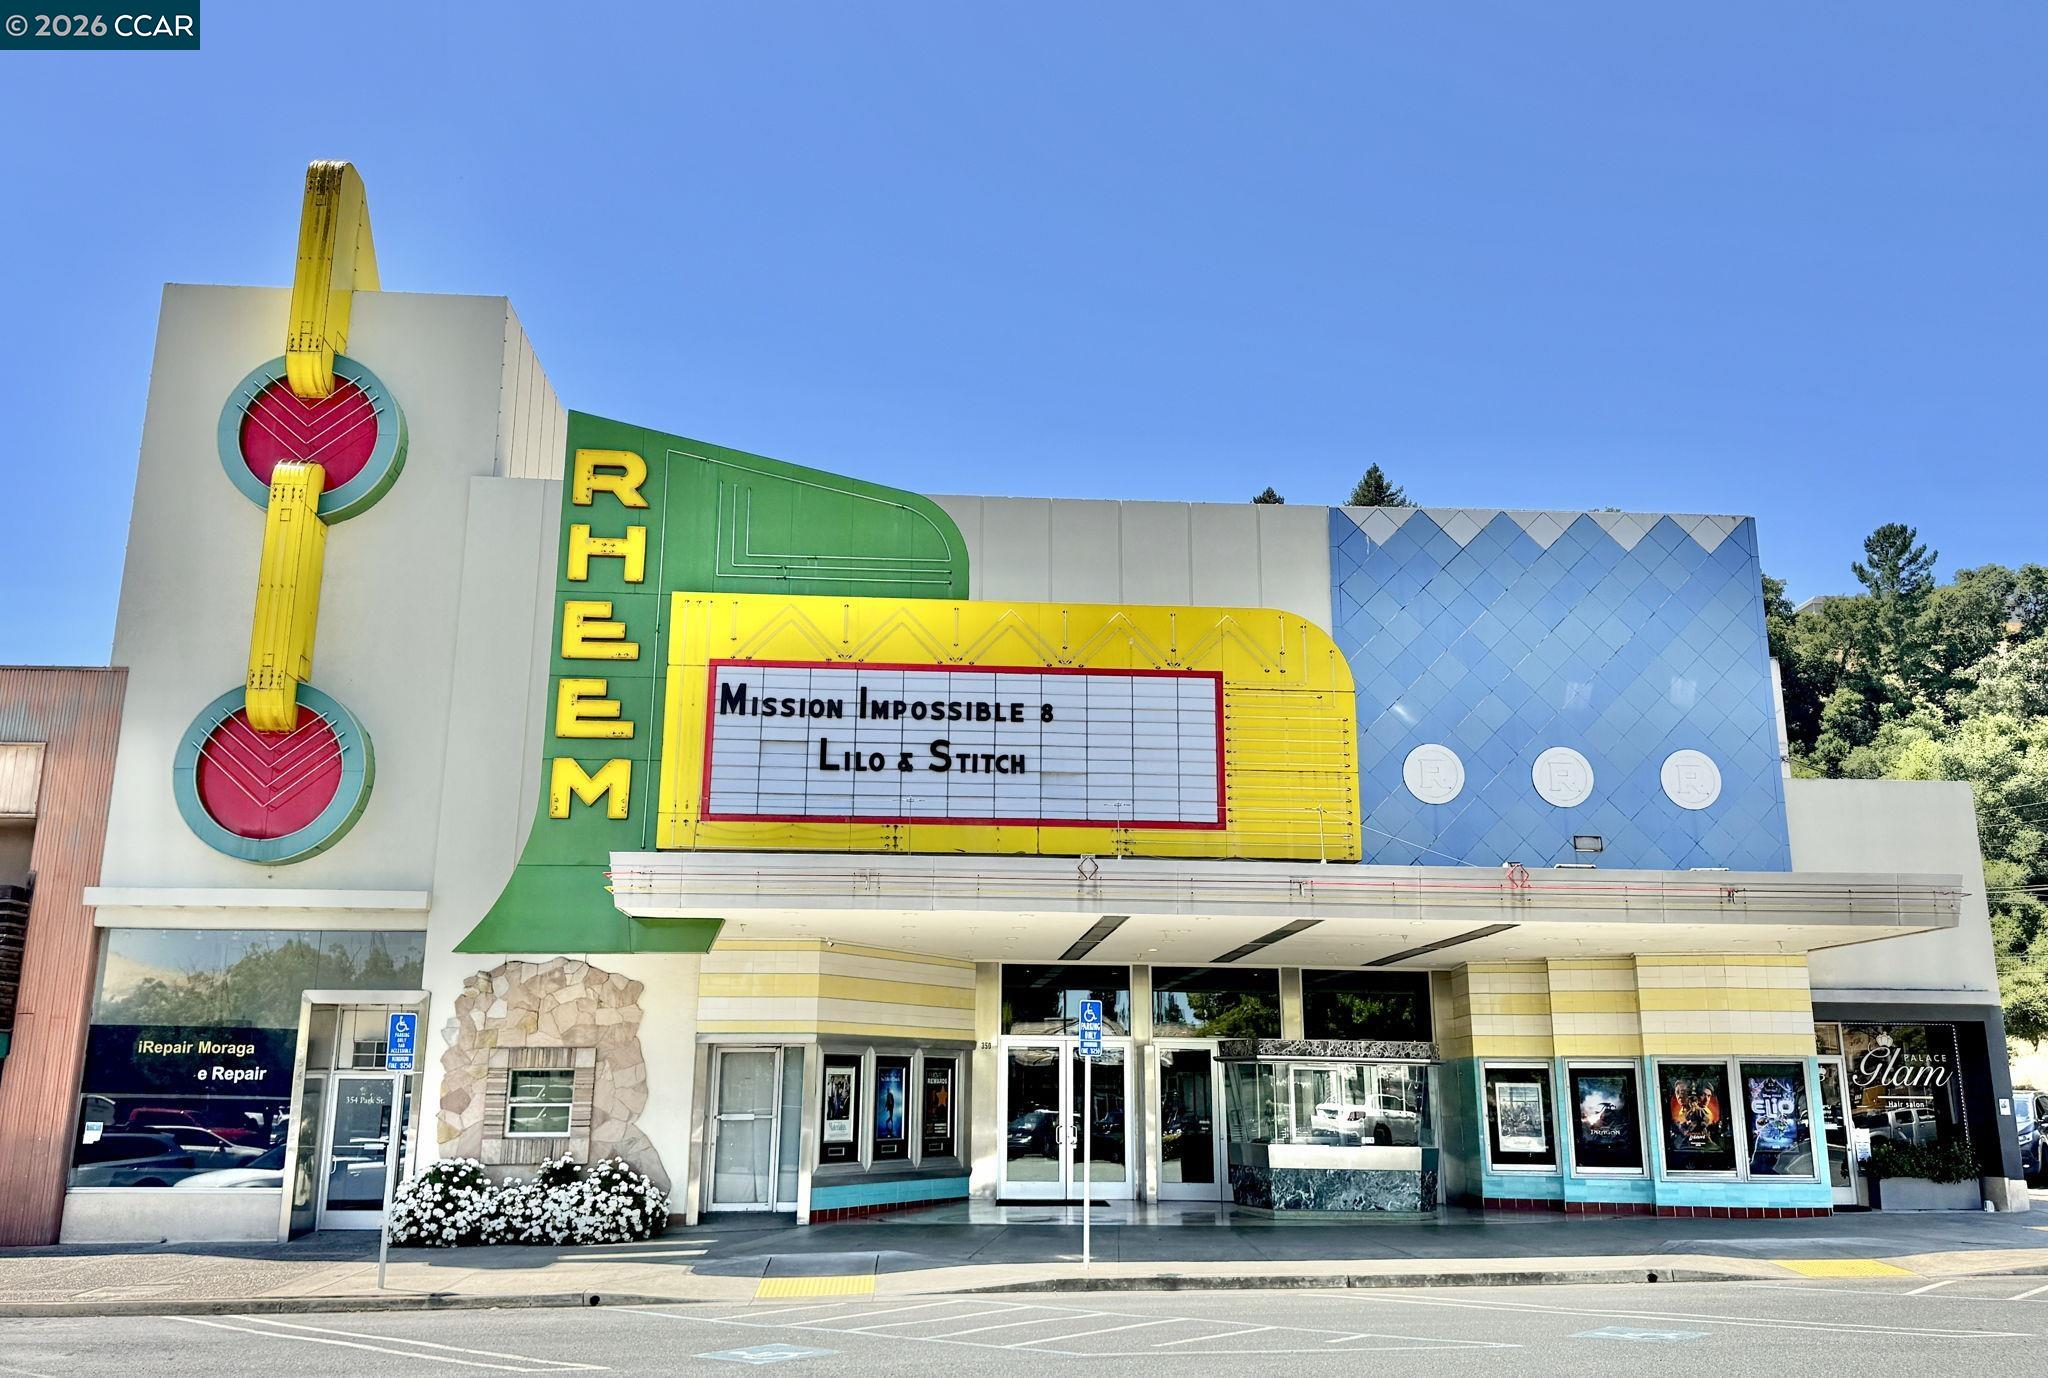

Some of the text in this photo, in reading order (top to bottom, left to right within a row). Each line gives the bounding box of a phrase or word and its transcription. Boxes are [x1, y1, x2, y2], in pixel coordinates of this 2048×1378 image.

[549, 448, 650, 820] RHEEM
[1040, 703, 1054, 723] 8
[898, 752, 914, 772] &
[138, 1040, 256, 1058] iRepair Moraga
[1903, 1053, 1947, 1063] PALACE
[1852, 1042, 1953, 1087] Glam
[211, 1066, 267, 1084] Repair
[346, 1096, 358, 1104] 354
[359, 1095, 375, 1105] Park
[1888, 1100, 1925, 1108] Hair salon
